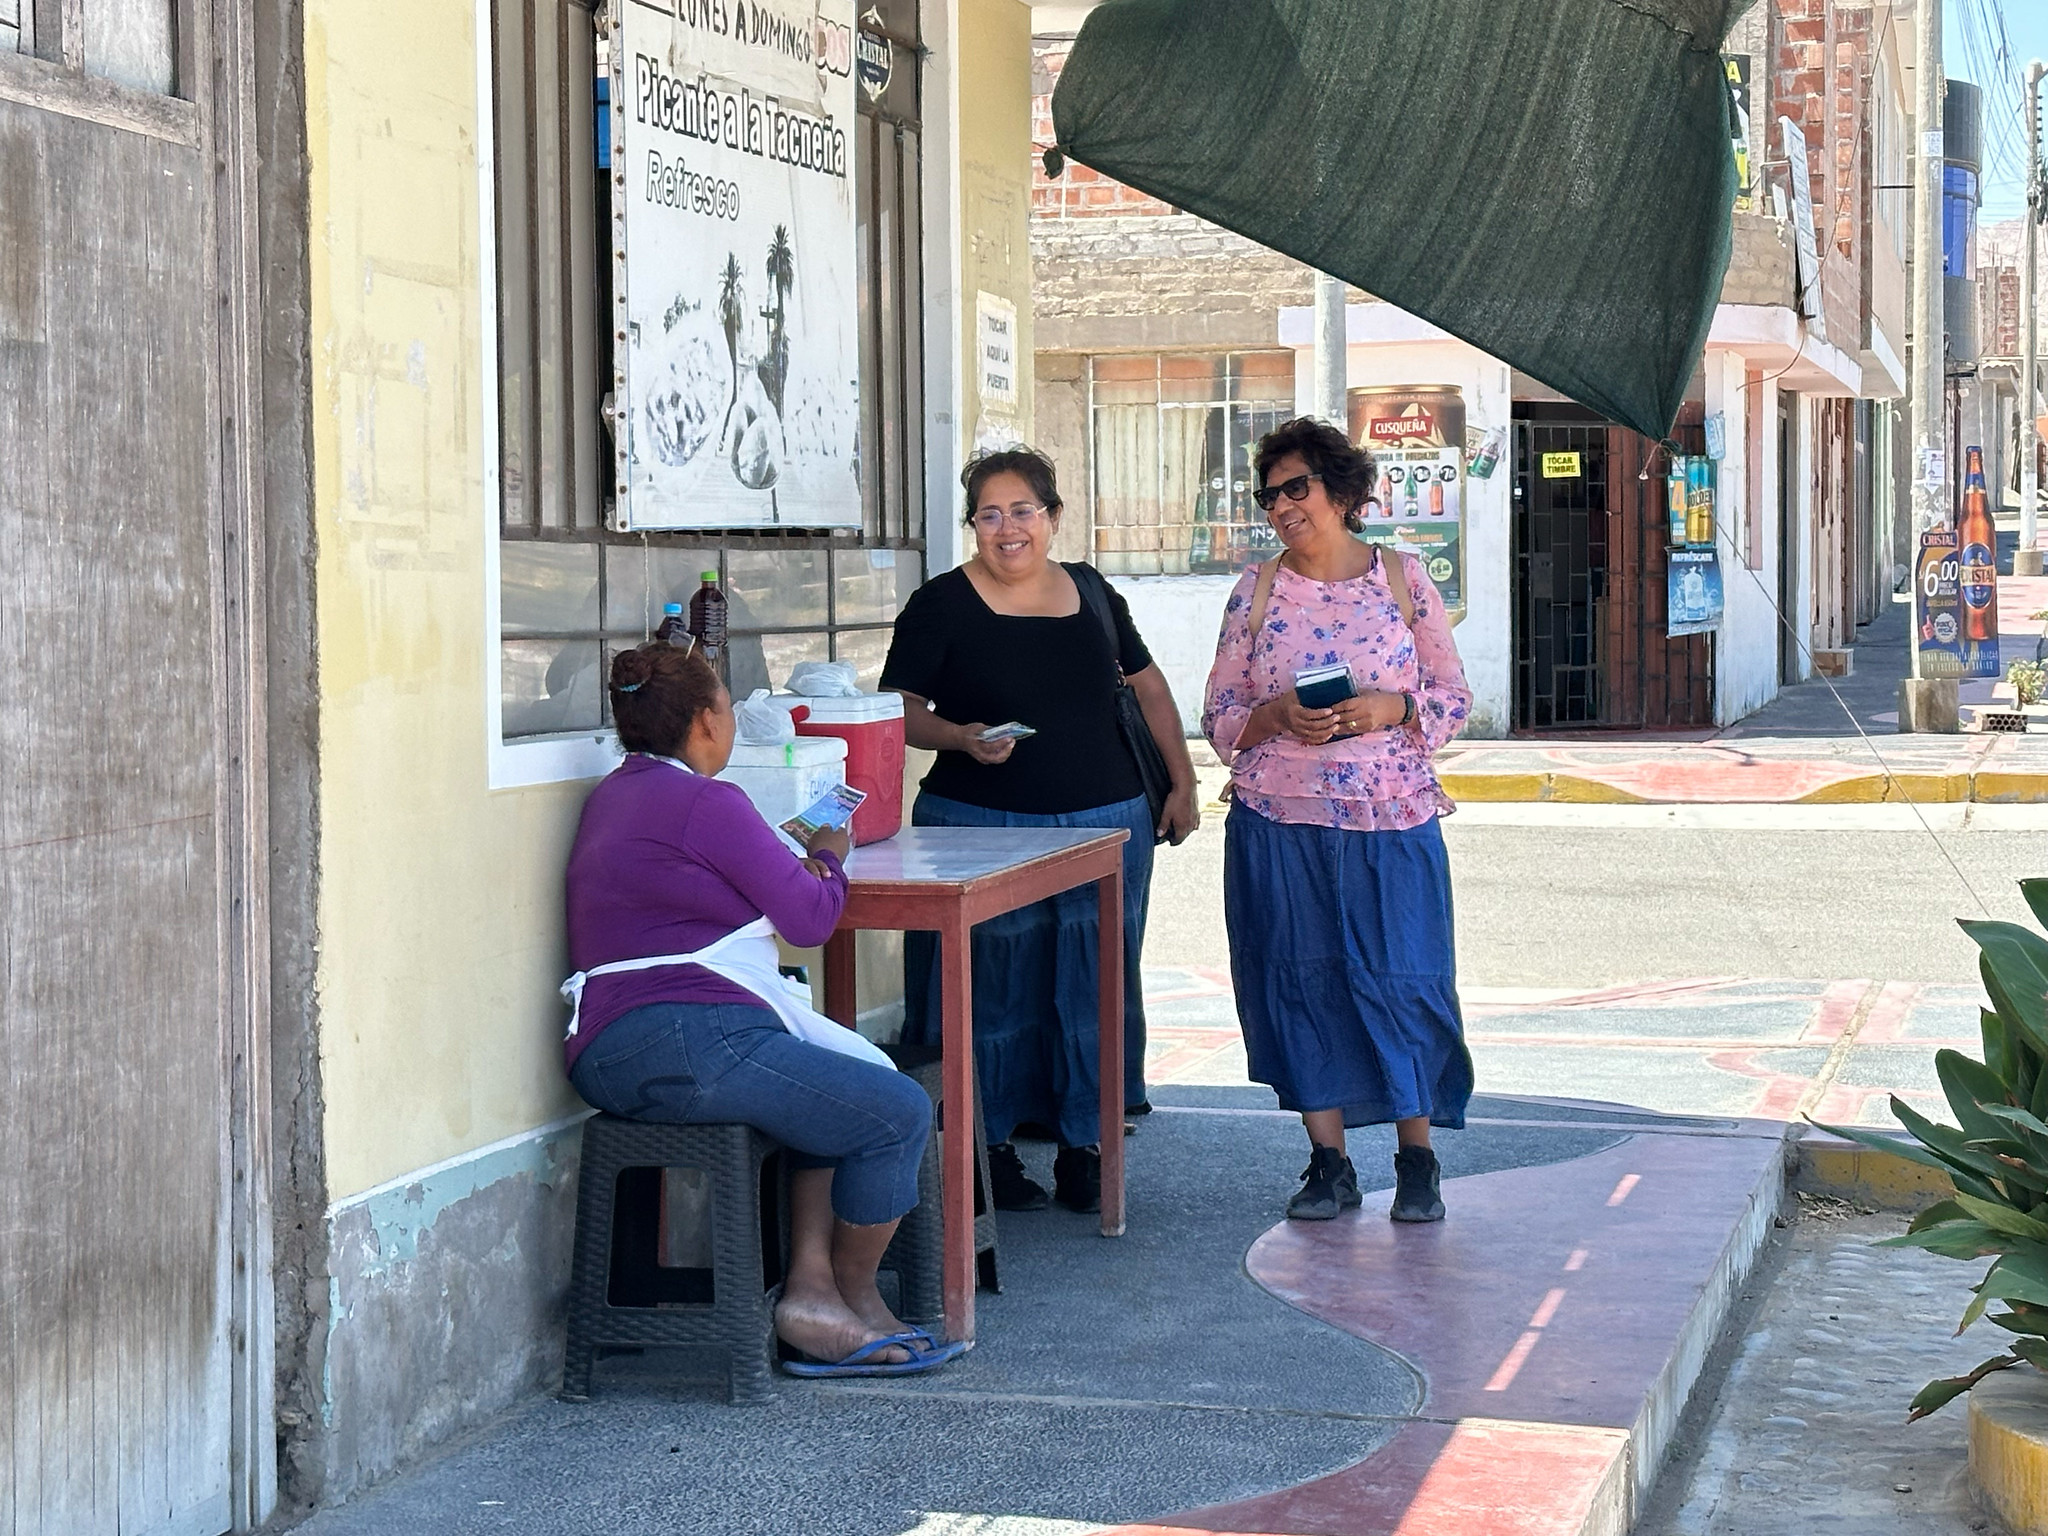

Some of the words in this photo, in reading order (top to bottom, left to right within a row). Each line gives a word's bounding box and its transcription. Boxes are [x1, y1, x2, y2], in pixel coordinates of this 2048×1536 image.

[735, 0, 748, 45] A
[636, 52, 719, 144] Picante
[724, 95, 739, 150] a
[742, 87, 763, 156] la
[765, 94, 846, 178] Tacneña
[646, 149, 740, 221] Refresco
[987, 316, 1007, 335] TOCAR
[1001, 349, 1010, 365] LA
[987, 373, 1009, 391] PUERTA
[1375, 418, 1427, 436] CUSQUEÑA
[1547, 456, 1573, 465] TOCAR
[1547, 465, 1576, 474] TIMBRE
[1922, 534, 1956, 546] CRISTAL
[1924, 560, 1959, 597] 6.00
[1960, 567, 1994, 584] CRISTAL
